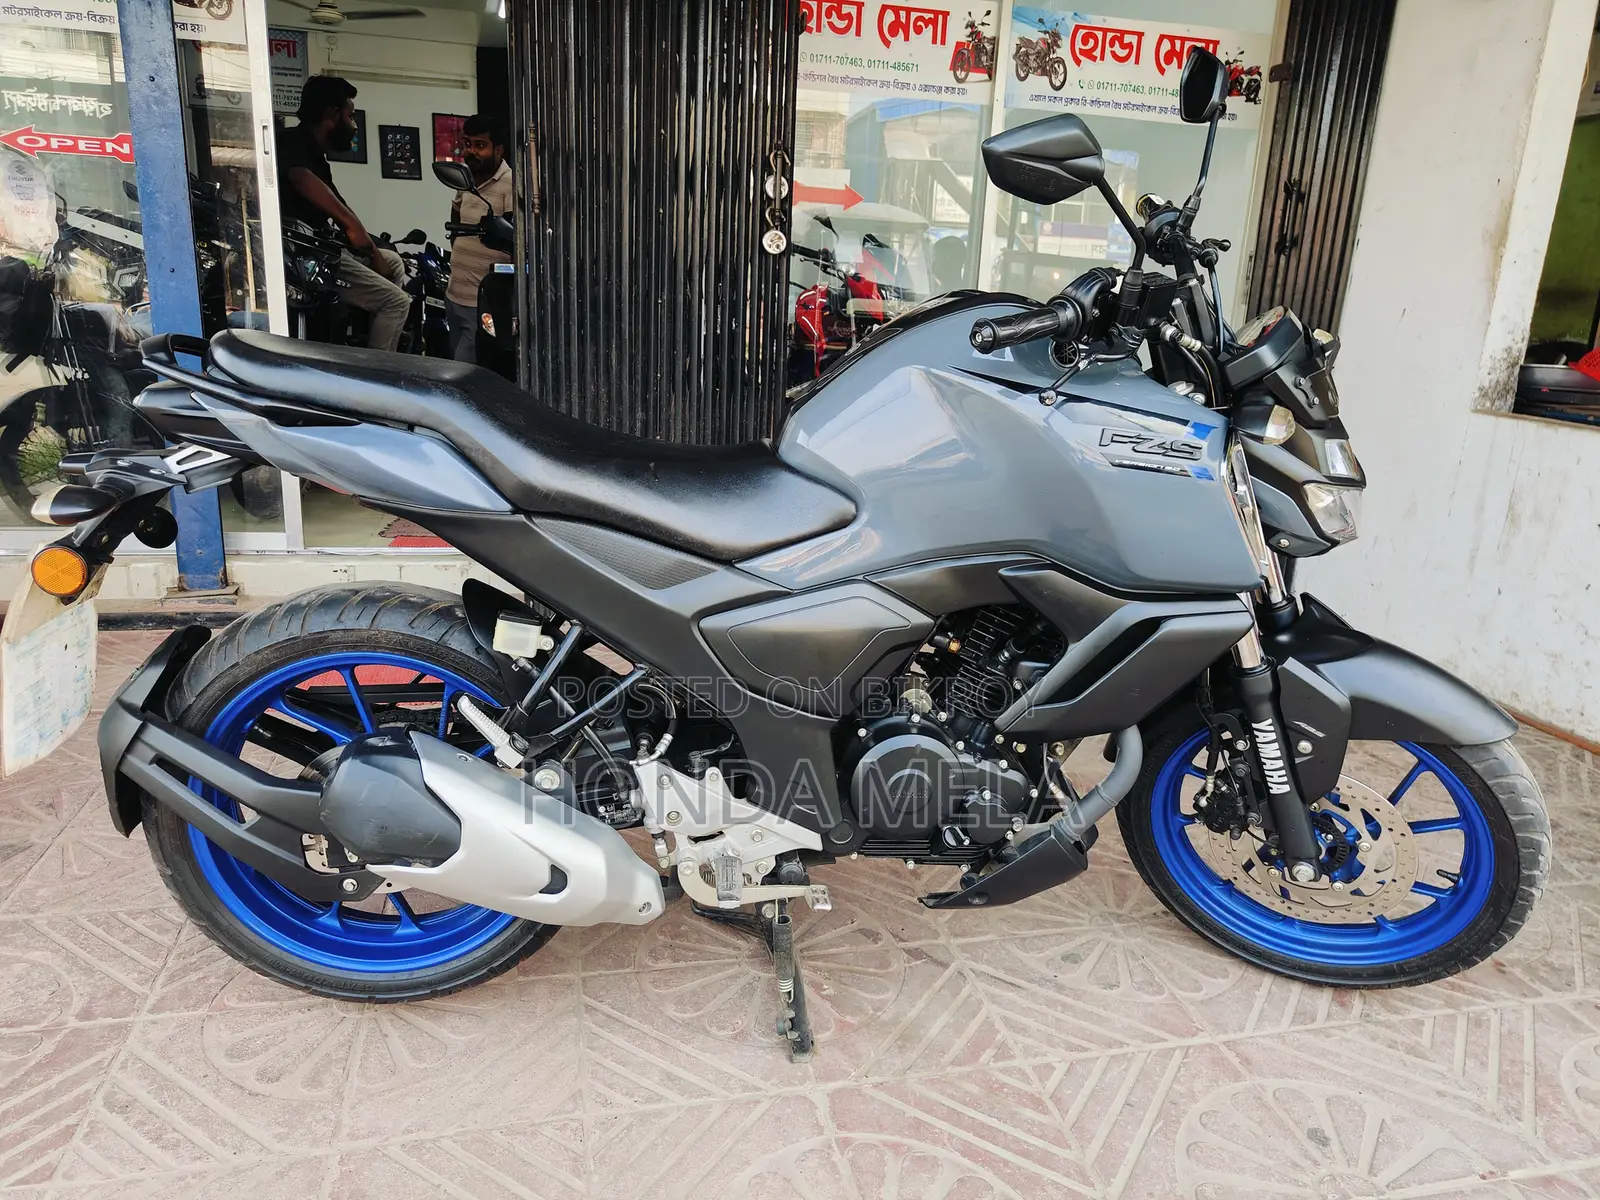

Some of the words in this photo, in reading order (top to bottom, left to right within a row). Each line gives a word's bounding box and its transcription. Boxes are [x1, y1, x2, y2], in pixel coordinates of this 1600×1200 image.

[2, 5, 62, 19] মটরসাইকেল
[64, 10, 116, 24] ক্রয়-বিক্রয়
[877, 4, 950, 49] মেলা
[1069, 24, 1145, 67] হোন্ডা
[809, 53, 865, 68] 01711-707463,
[867, 58, 919, 73] 01711-485671
[840, 75, 878, 88] মটরসাইকেল
[879, 80, 911, 91] ক্রয়-বিক্রয়
[911, 83, 917, 91] ও
[943, 86, 956, 95] করা
[1148, 86, 1179, 98] 01711-48
[1028, 94, 1046, 103] এখানে
[1047, 95, 1063, 105] সকল
[1064, 97, 1080, 107] প্রকার
[17, 135, 131, 155] OPEN
[1251, 718, 1291, 795] YAMAHA
